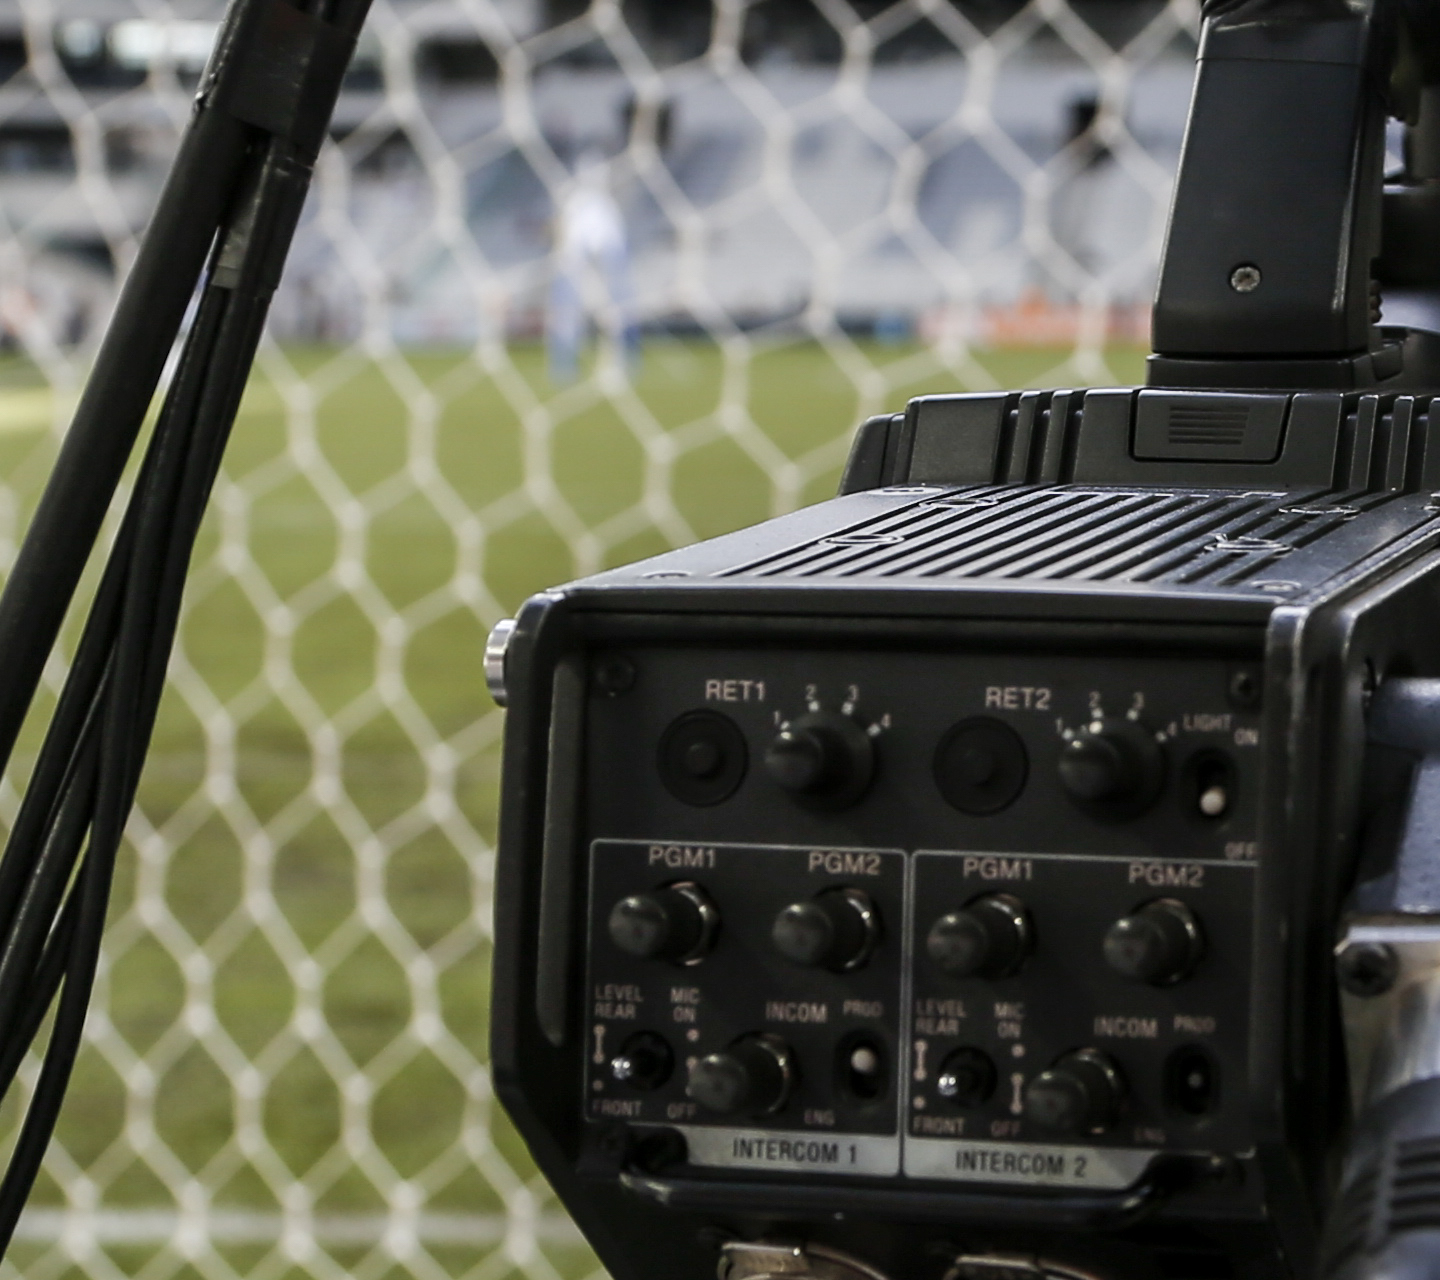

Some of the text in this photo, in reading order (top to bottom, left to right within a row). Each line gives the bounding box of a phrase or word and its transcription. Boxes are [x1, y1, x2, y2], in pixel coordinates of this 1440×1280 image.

[705, 680, 765, 701] RET1
[806, 684, 817, 701] 2
[848, 685, 858, 701] 3
[985, 686, 1051, 710] RET2
[1089, 690, 1101, 708] 2
[1134, 691, 1145, 710] 3
[1183, 713, 1233, 732] LIGHT
[648, 846, 716, 868] PGM1
[809, 852, 881, 875] PGM2
[963, 856, 1033, 881] PGM1
[1128, 862, 1205, 888] PGM2
[595, 984, 644, 1003] LEVEL
[670, 986, 700, 1004] MIC
[594, 1003, 636, 1019] REAR
[673, 1006, 697, 1023] ON
[765, 1001, 828, 1023] INCOM
[916, 998, 966, 1018] LEVEL
[993, 1001, 1025, 1020] MIC
[914, 1017, 959, 1035] REAR
[997, 1021, 1022, 1039] ON
[1093, 1015, 1158, 1038] INCOM
[593, 1100, 642, 1117] FRONT
[733, 1138, 857, 1163] INTERCOM 1
[956, 1150, 1087, 1176] INTERCOM 2
